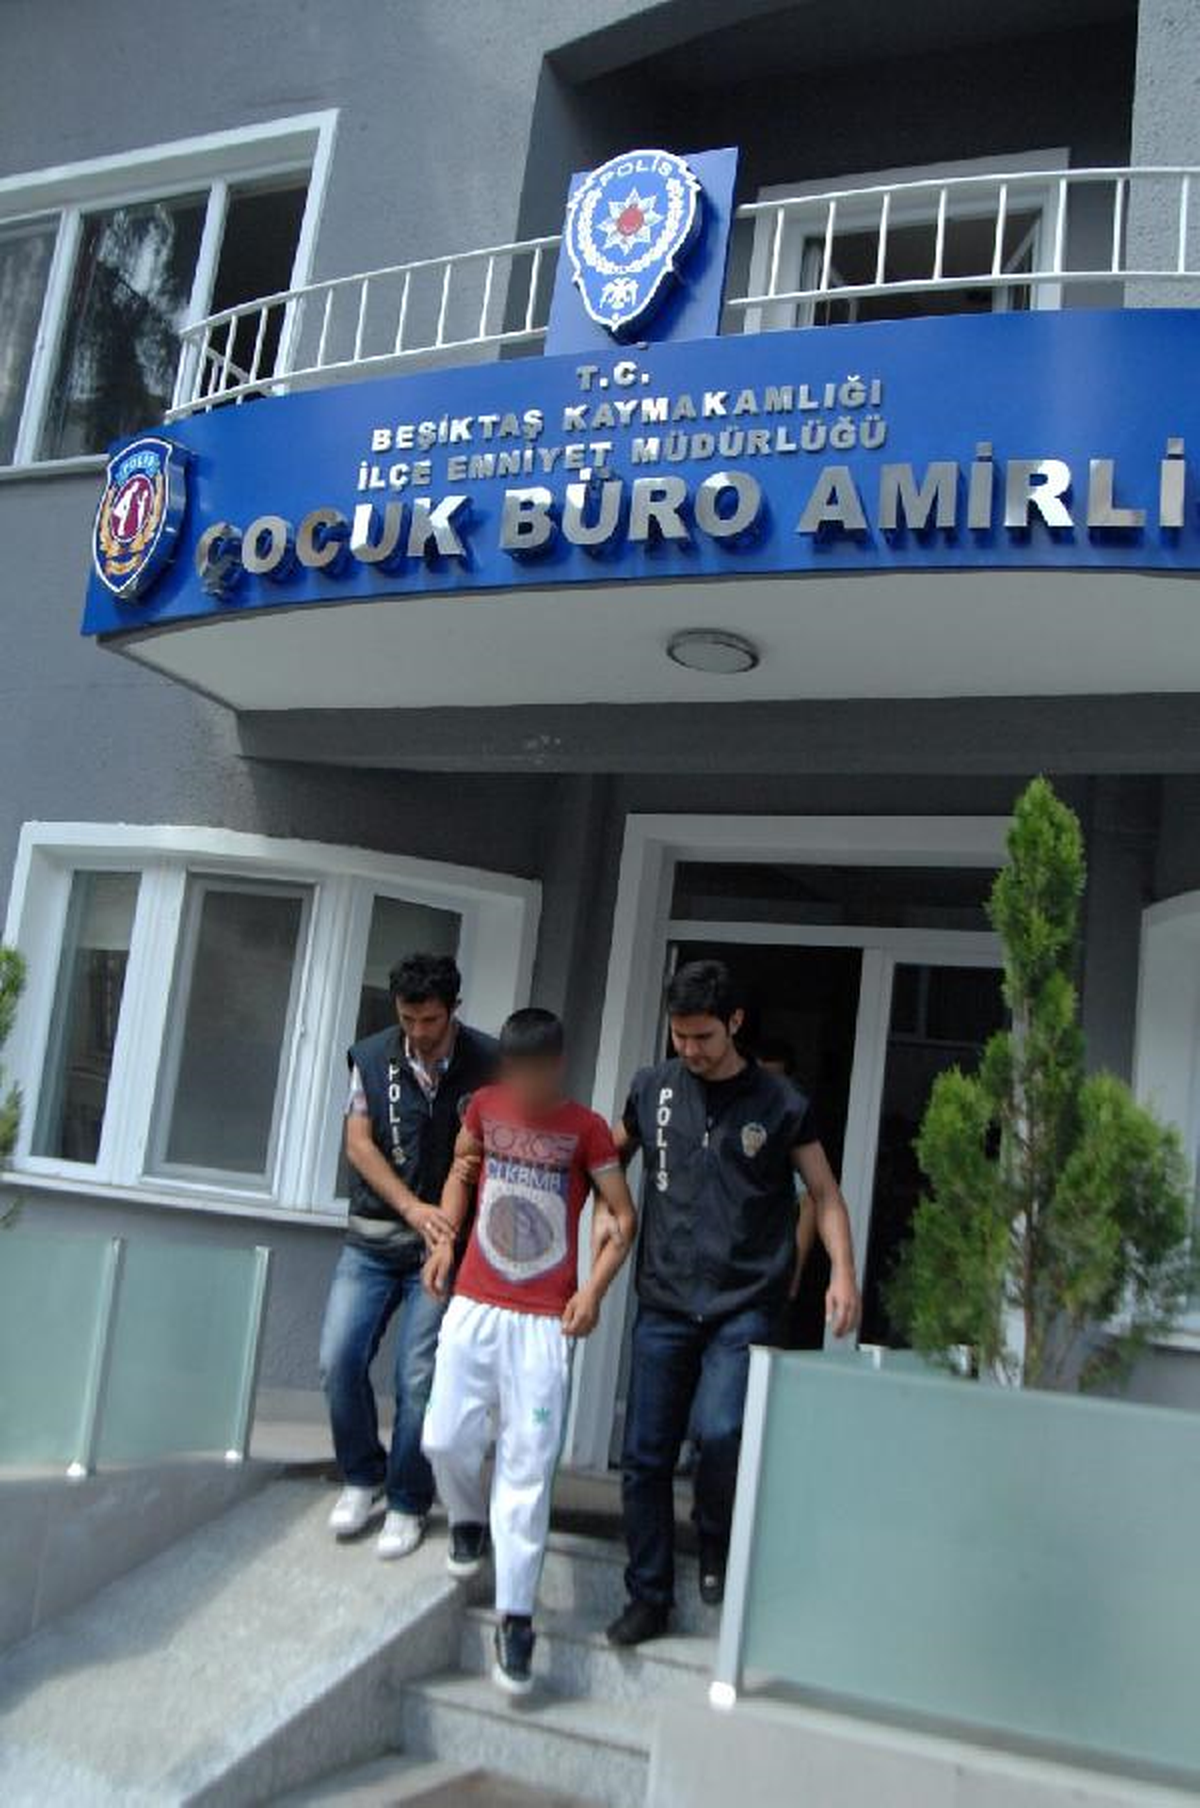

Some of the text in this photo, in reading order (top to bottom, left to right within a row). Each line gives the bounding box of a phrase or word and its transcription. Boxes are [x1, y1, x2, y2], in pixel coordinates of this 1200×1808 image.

[371, 374, 882, 451] BEŞİKTAŞ KAYMAKAMLIĞI
[575, 361, 650, 391] T.C.
[357, 414, 887, 492] İLÇE EMNİYET MÜDÜRLÜĞÜ
[195, 494, 468, 595] ÇOCUK
[502, 466, 762, 552] BÜRO
[656, 1087, 673, 1193] POLIS
